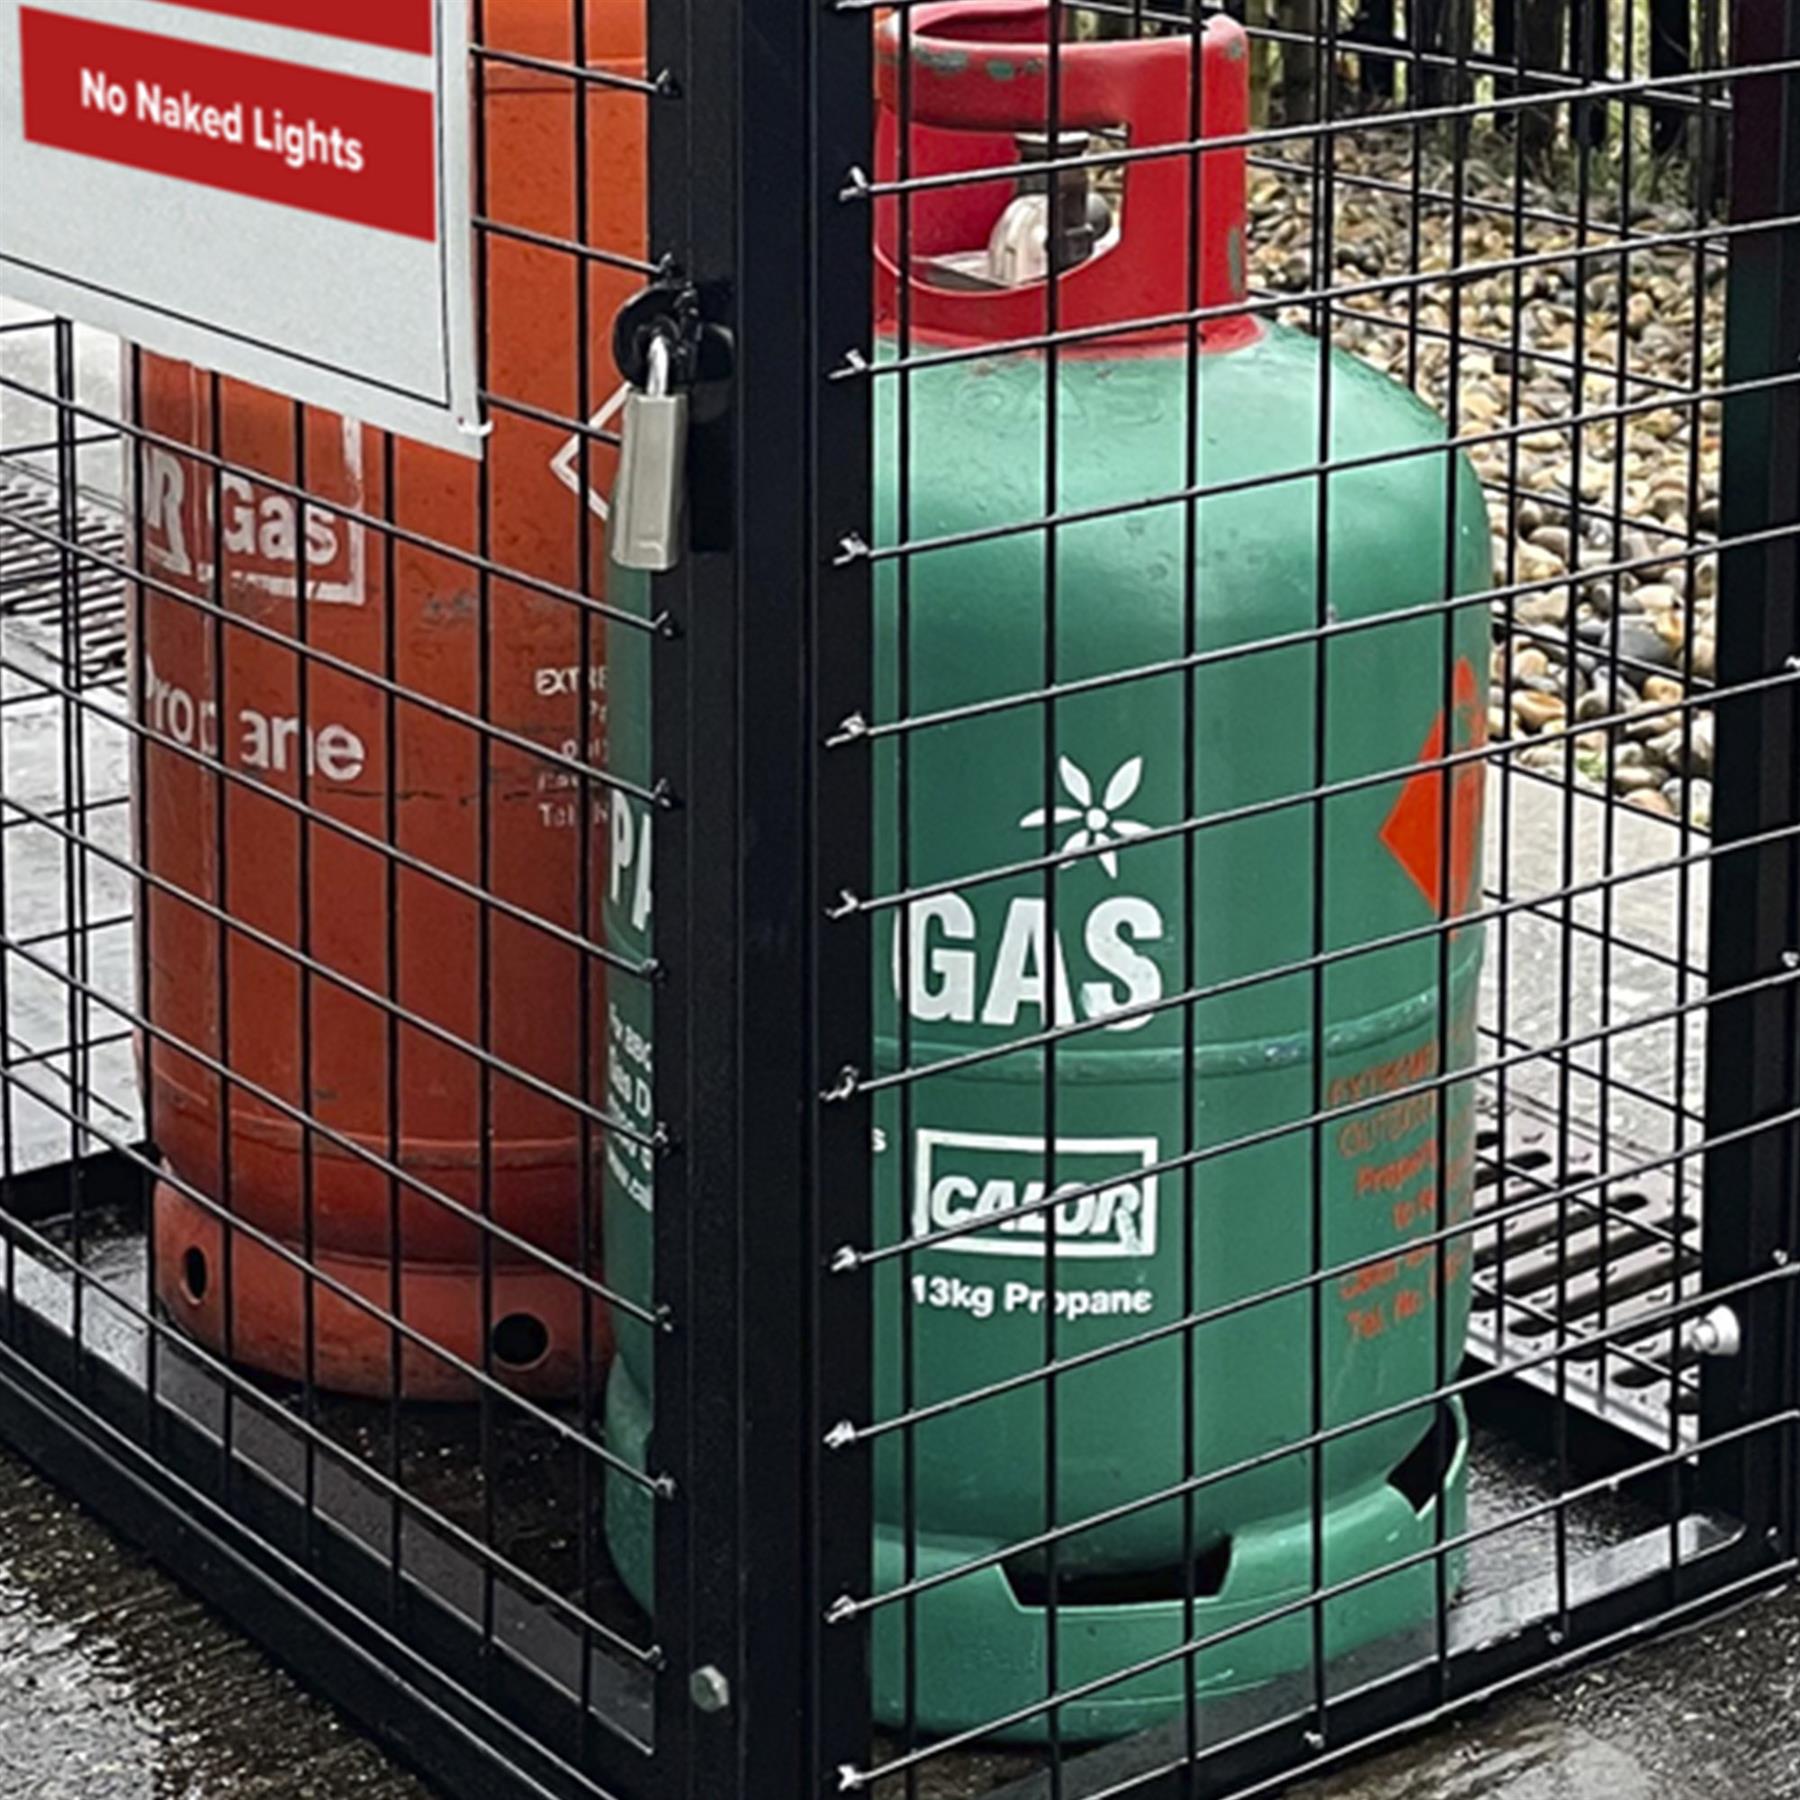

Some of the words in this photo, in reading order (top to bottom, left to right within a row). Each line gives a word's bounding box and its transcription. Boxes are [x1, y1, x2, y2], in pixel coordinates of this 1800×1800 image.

[80, 68, 126, 115] No
[136, 81, 242, 143] Naked
[253, 107, 364, 172] Lights
[208, 471, 337, 565] Gas
[893, 891, 1163, 1031] GAS
[931, 1175, 1142, 1254] CALOR
[911, 1275, 994, 1319] 13kg
